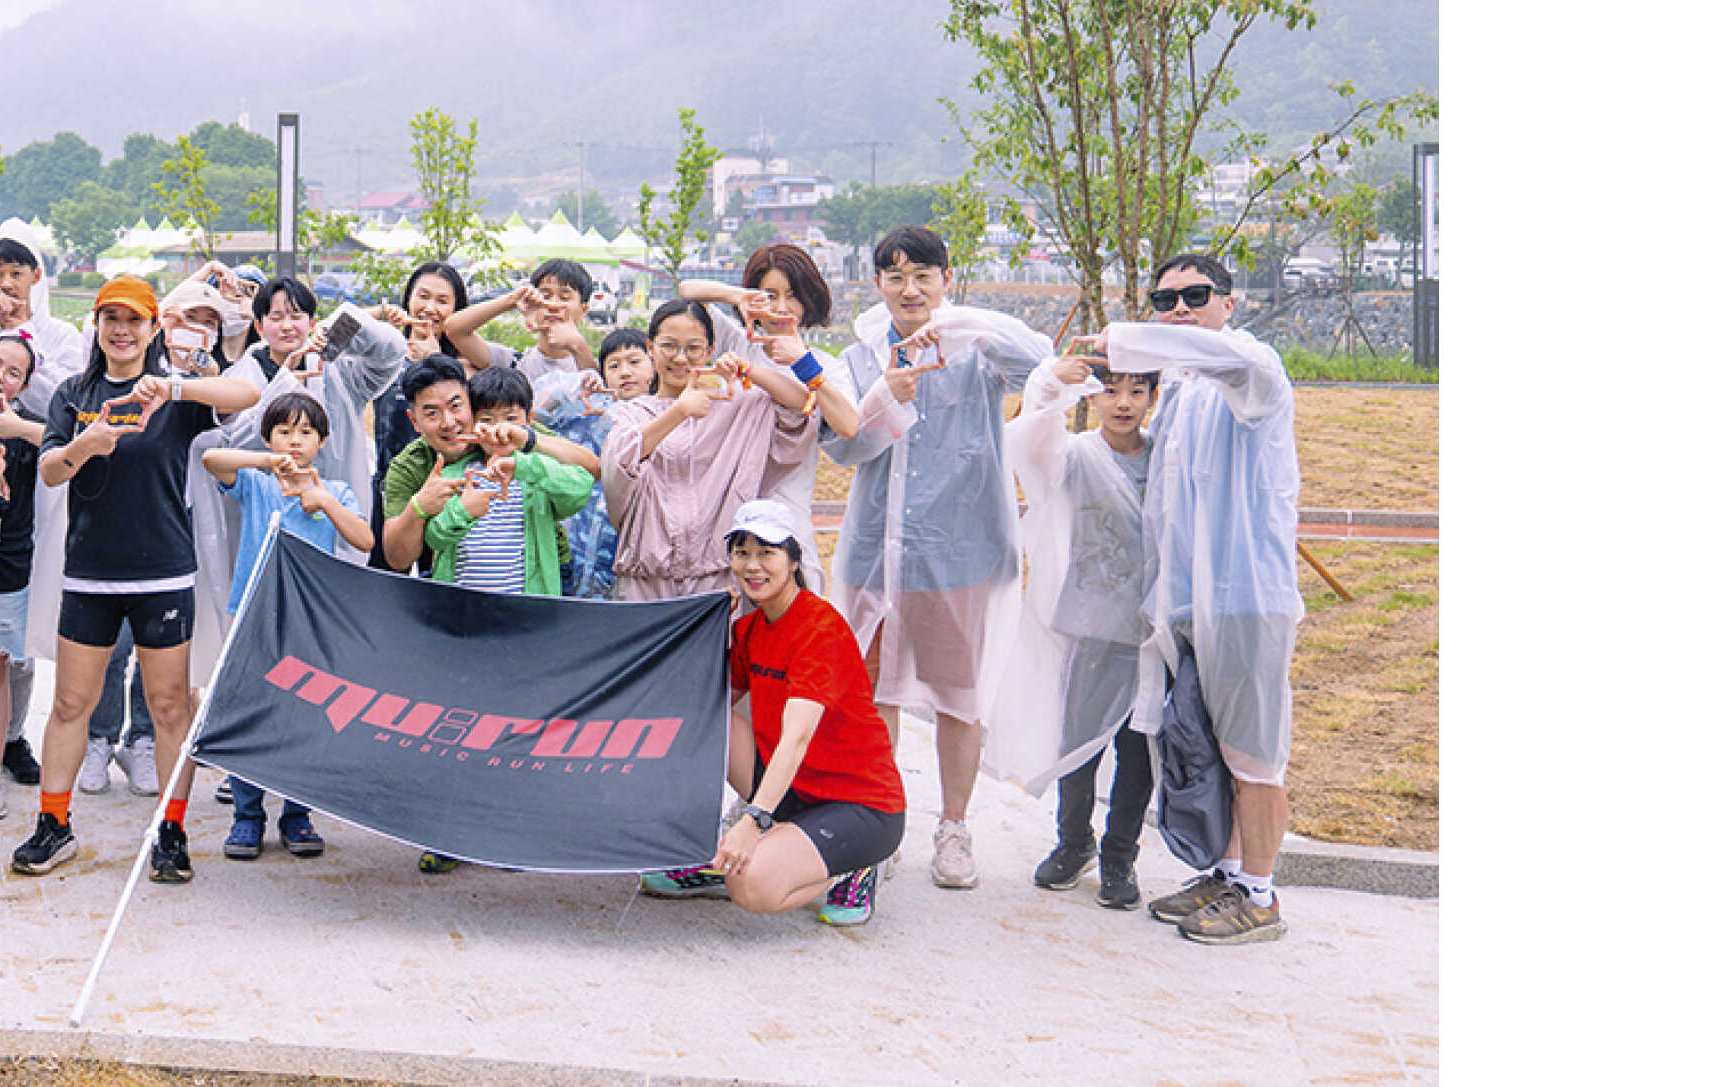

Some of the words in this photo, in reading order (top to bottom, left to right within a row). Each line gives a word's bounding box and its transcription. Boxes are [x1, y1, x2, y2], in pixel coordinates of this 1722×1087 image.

[373, 731, 469, 762] MUSIC
[487, 757, 548, 772] RUN
[563, 762, 635, 775] LIFE
